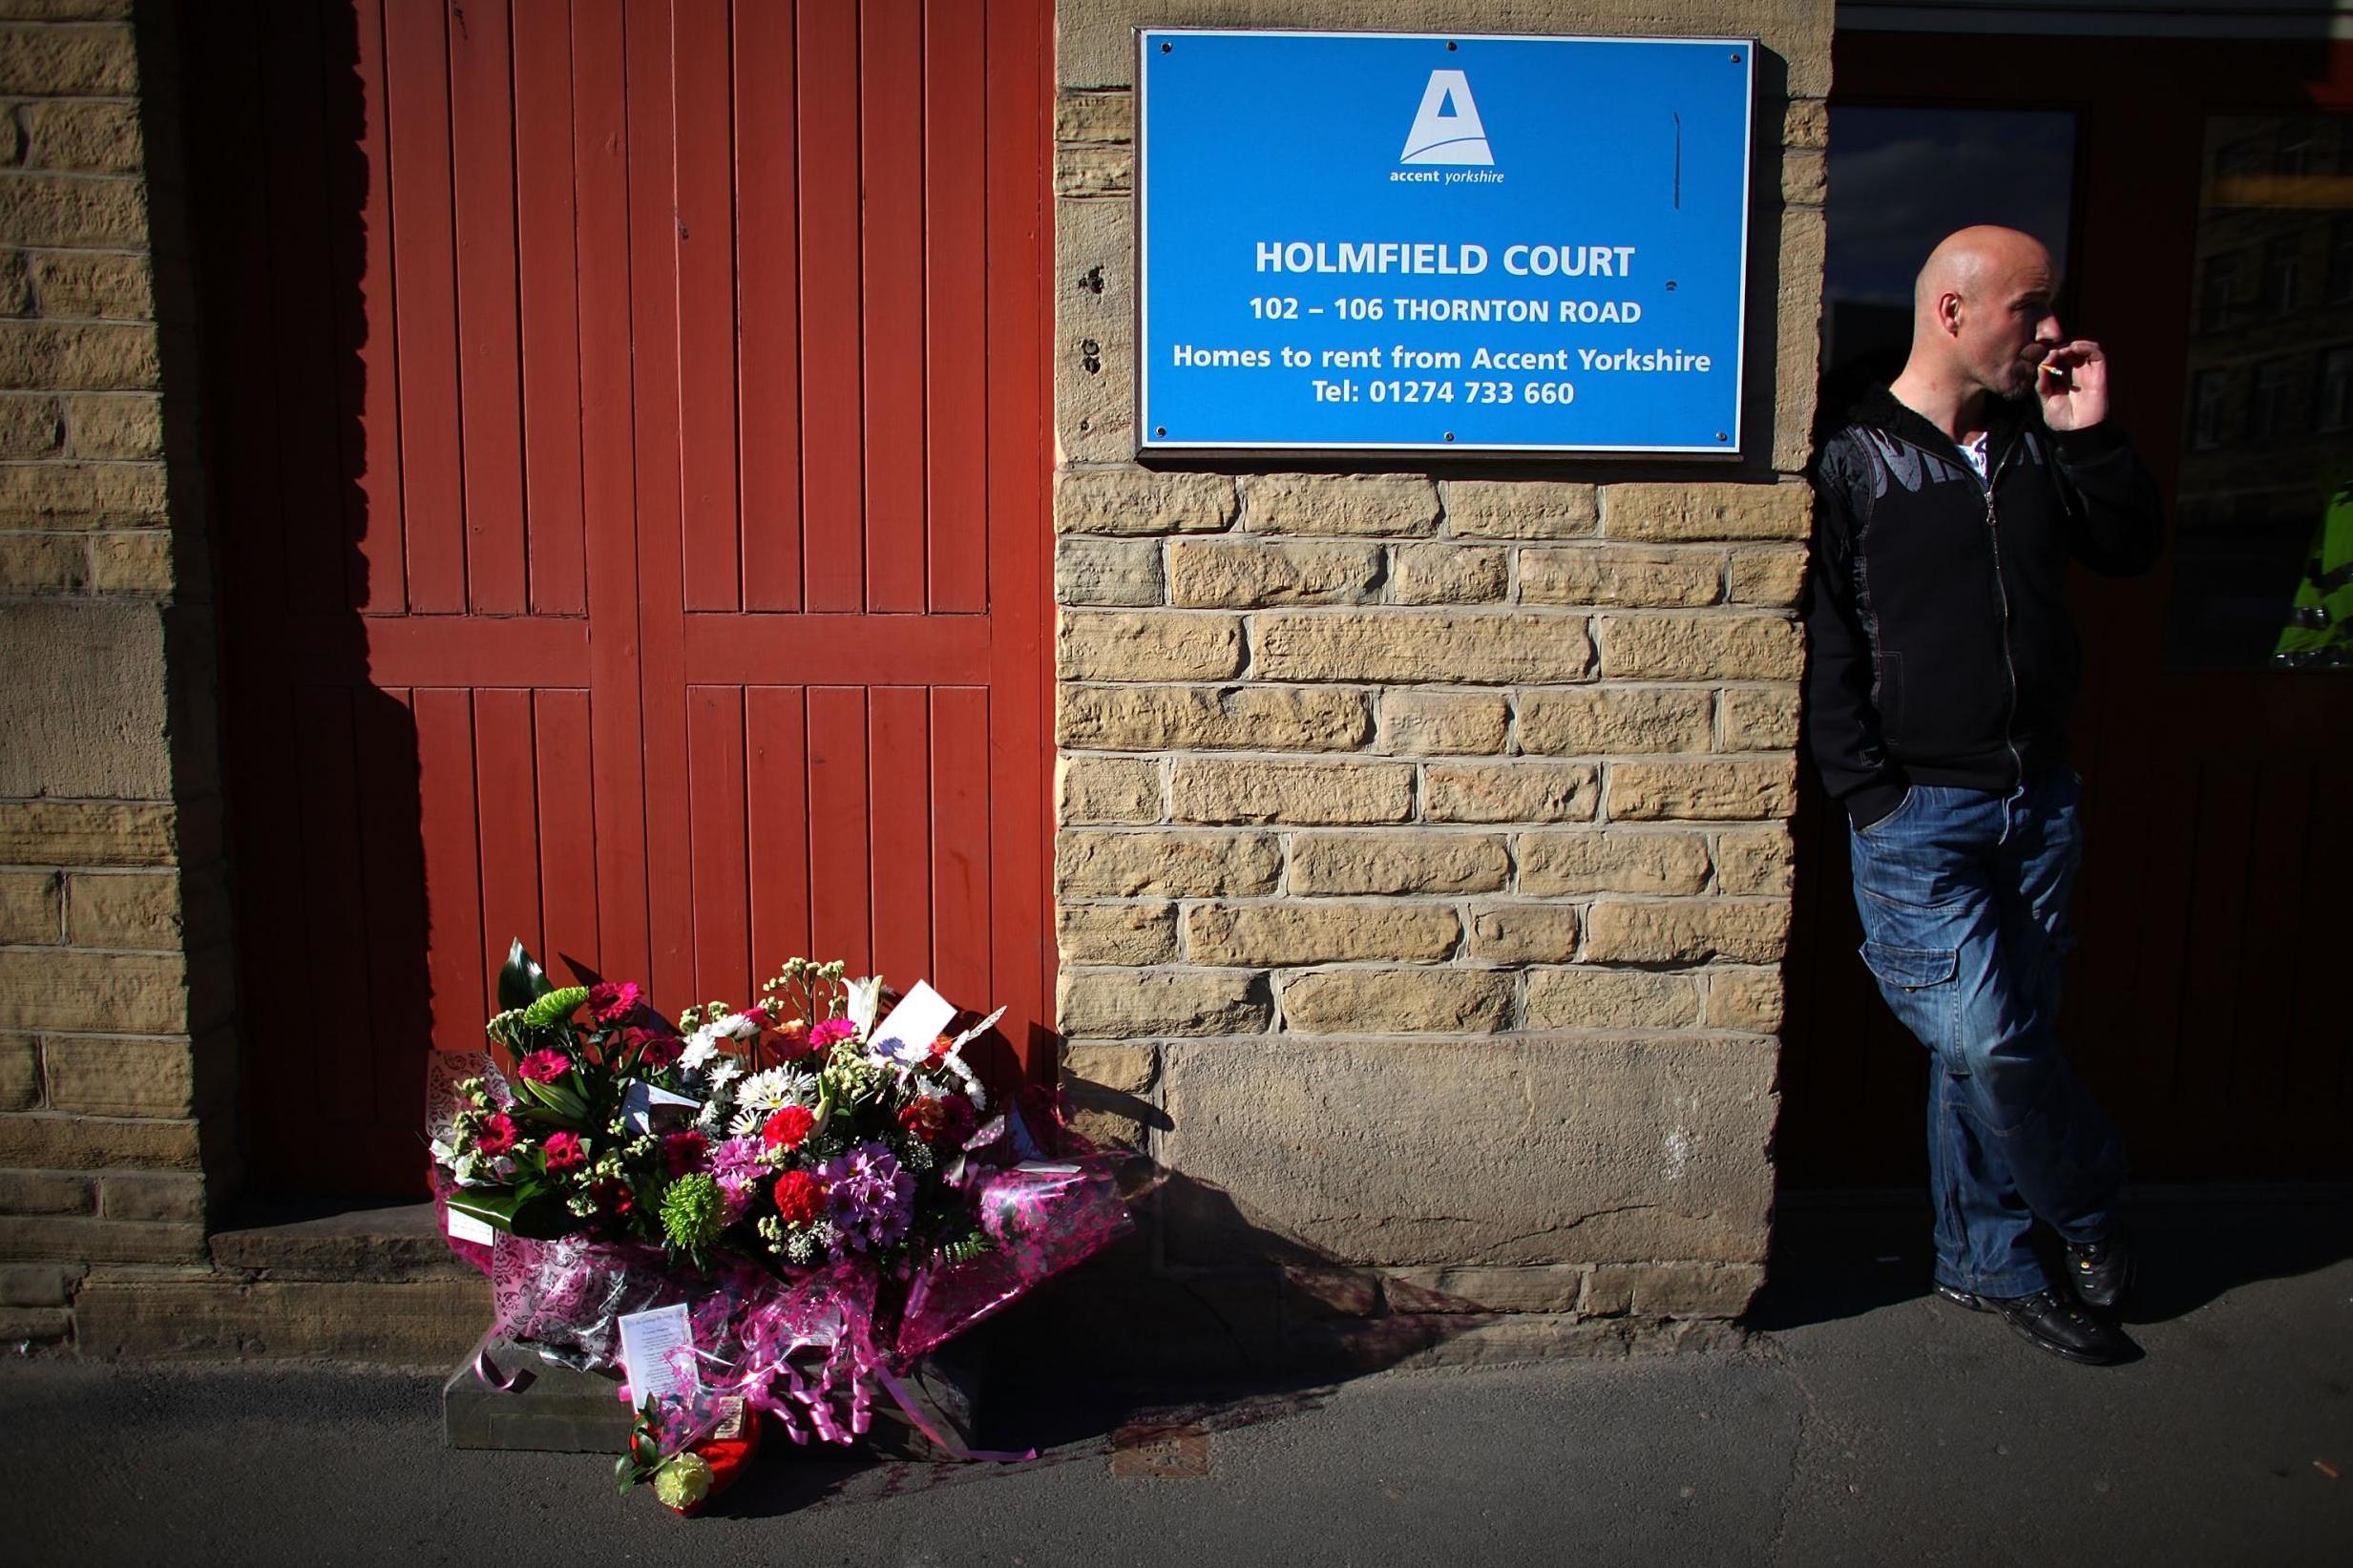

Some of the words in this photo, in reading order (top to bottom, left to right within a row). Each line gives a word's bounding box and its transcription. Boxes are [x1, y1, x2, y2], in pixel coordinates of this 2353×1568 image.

[1390, 172, 1440, 182] accent
[1445, 170, 1504, 185] yorkshire
[1256, 241, 1488, 275] HOLMFIELD
[1503, 244, 1636, 277] COURT
[1250, 297, 1299, 320] 102
[1335, 298, 1384, 321] 106
[1394, 299, 1549, 323] THORNTON
[1560, 301, 1642, 324] ROAD
[1173, 345, 1271, 368] Homes
[1281, 346, 1312, 368] to
[1322, 347, 1382, 369] rent
[1391, 345, 1461, 370] from
[1471, 347, 1568, 370] Accent
[1578, 347, 1712, 373] Yorkshire
[1313, 380, 1359, 403] Tel:
[1369, 380, 1455, 404] 01274
[1465, 381, 1514, 404] 733
[1523, 382, 1575, 405] 660
